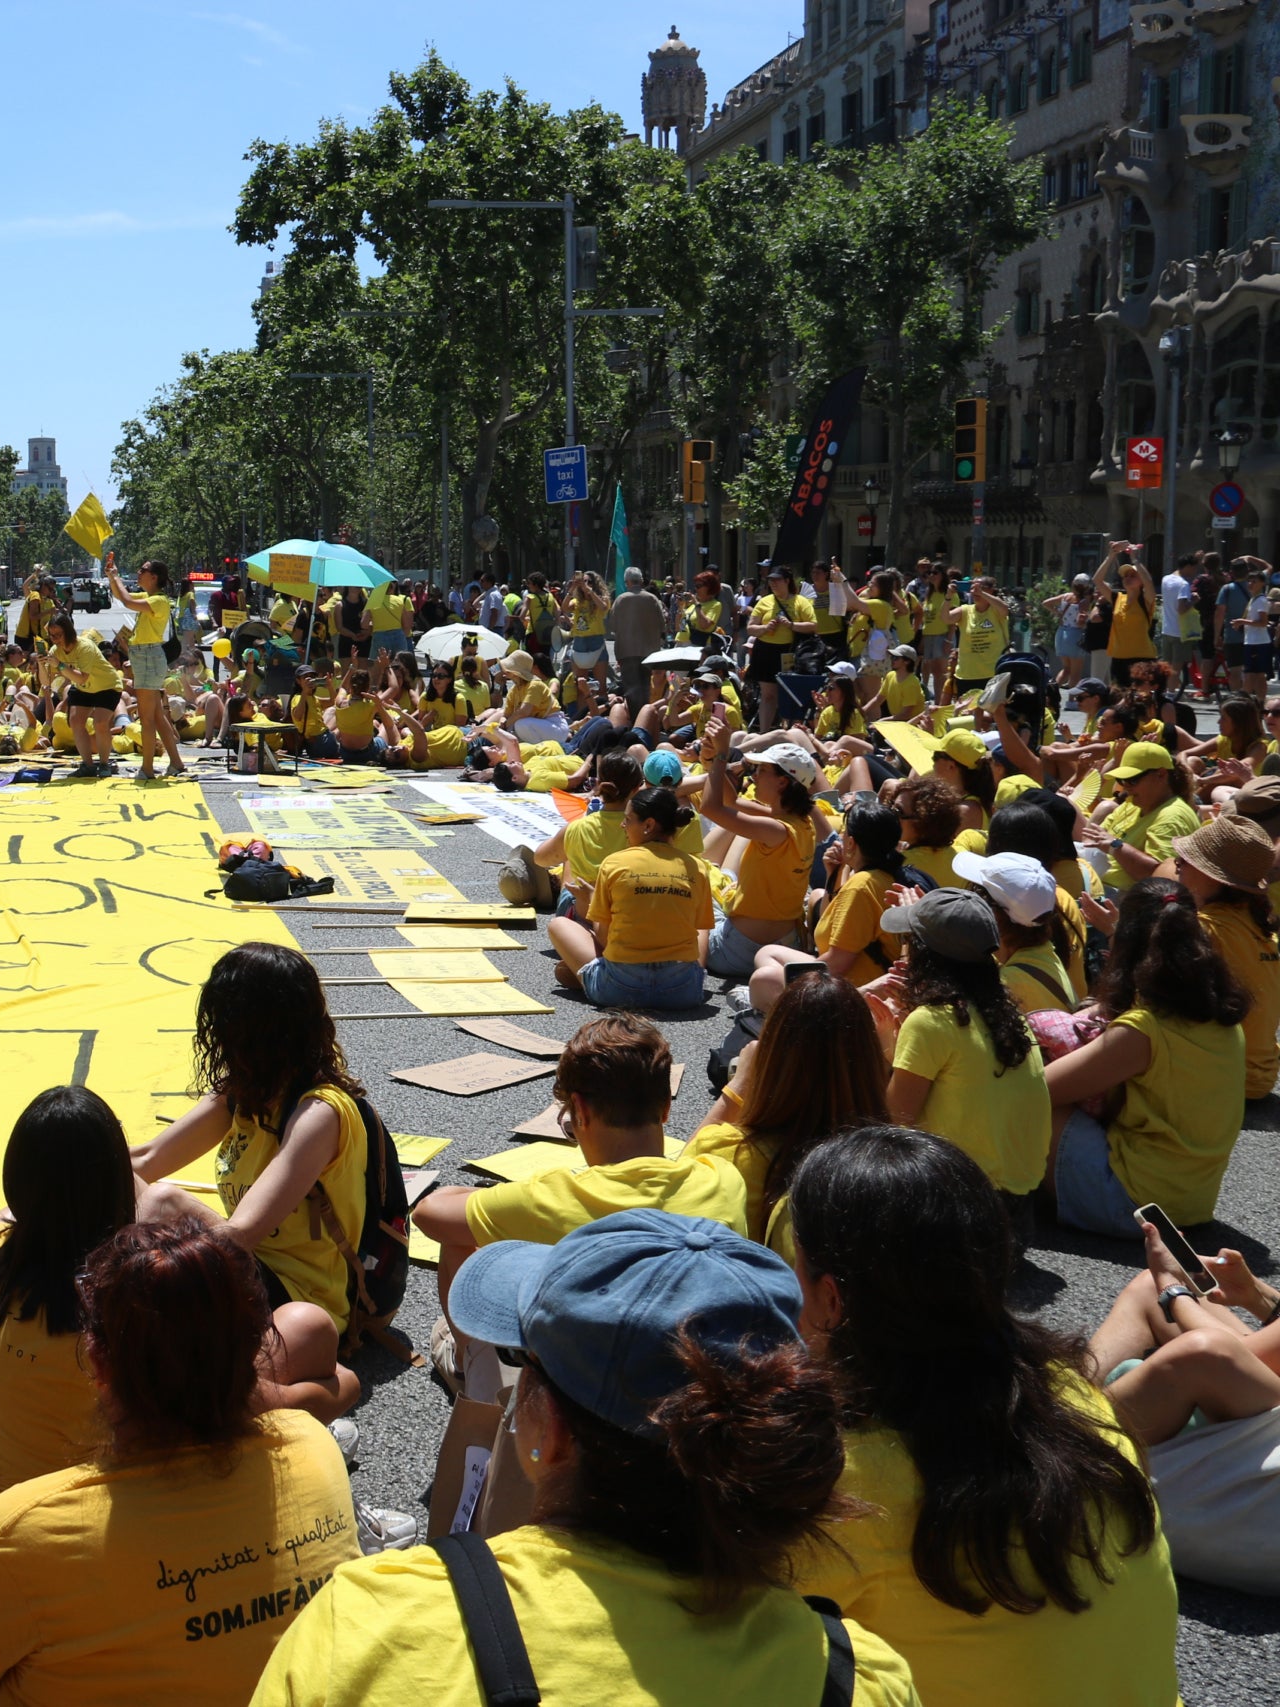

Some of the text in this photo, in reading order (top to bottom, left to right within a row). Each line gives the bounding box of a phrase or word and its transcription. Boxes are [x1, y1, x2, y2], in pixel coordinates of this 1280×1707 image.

[557, 468, 574, 481] taxi
[790, 419, 833, 518] ÁBACOS
[6, 1343, 37, 1363] TOT
[157, 1511, 348, 1603] dignitat i qualitat
[185, 1573, 334, 1642] SOM.INFÀN
